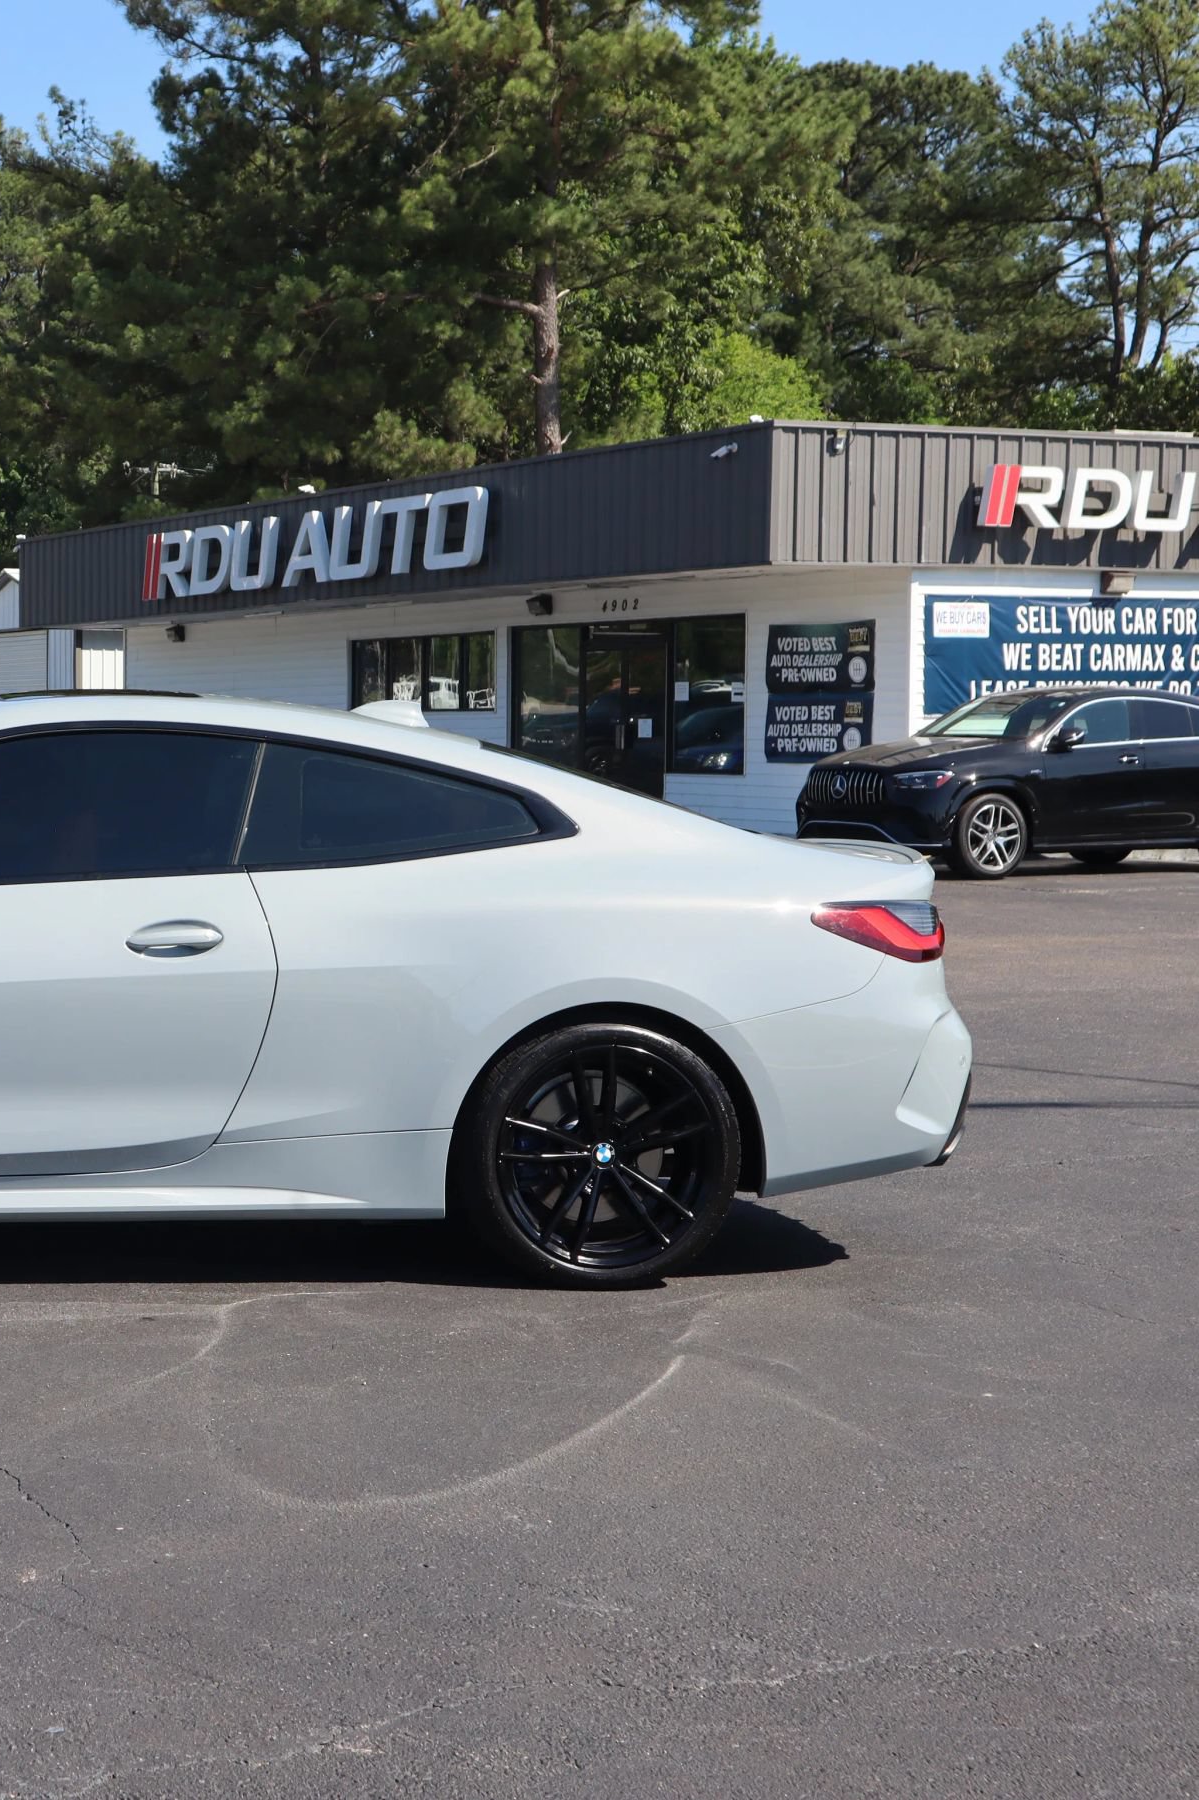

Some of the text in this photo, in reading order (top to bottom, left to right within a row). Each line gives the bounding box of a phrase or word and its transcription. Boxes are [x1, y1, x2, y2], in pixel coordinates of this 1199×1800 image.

[1015, 465, 1198, 532] RDU
[156, 486, 489, 599] RDU AUTO
[601, 598, 639, 613] 4902
[936, 611, 986, 625] WE BUY CARS
[1016, 605, 1197, 635] SELL YOUR CAR FOR
[777, 636, 837, 652] VOTED BEST
[771, 653, 842, 667] AUTO DEALERSHIP
[1003, 643, 1032, 671] WE
[1038, 643, 1084, 671] BEAT
[1089, 643, 1166, 672] CARMAX
[1170, 644, 1185, 672] &
[775, 705, 836, 721] VOTED BEST
[767, 723, 842, 737] AUTO DEALERSHIP
